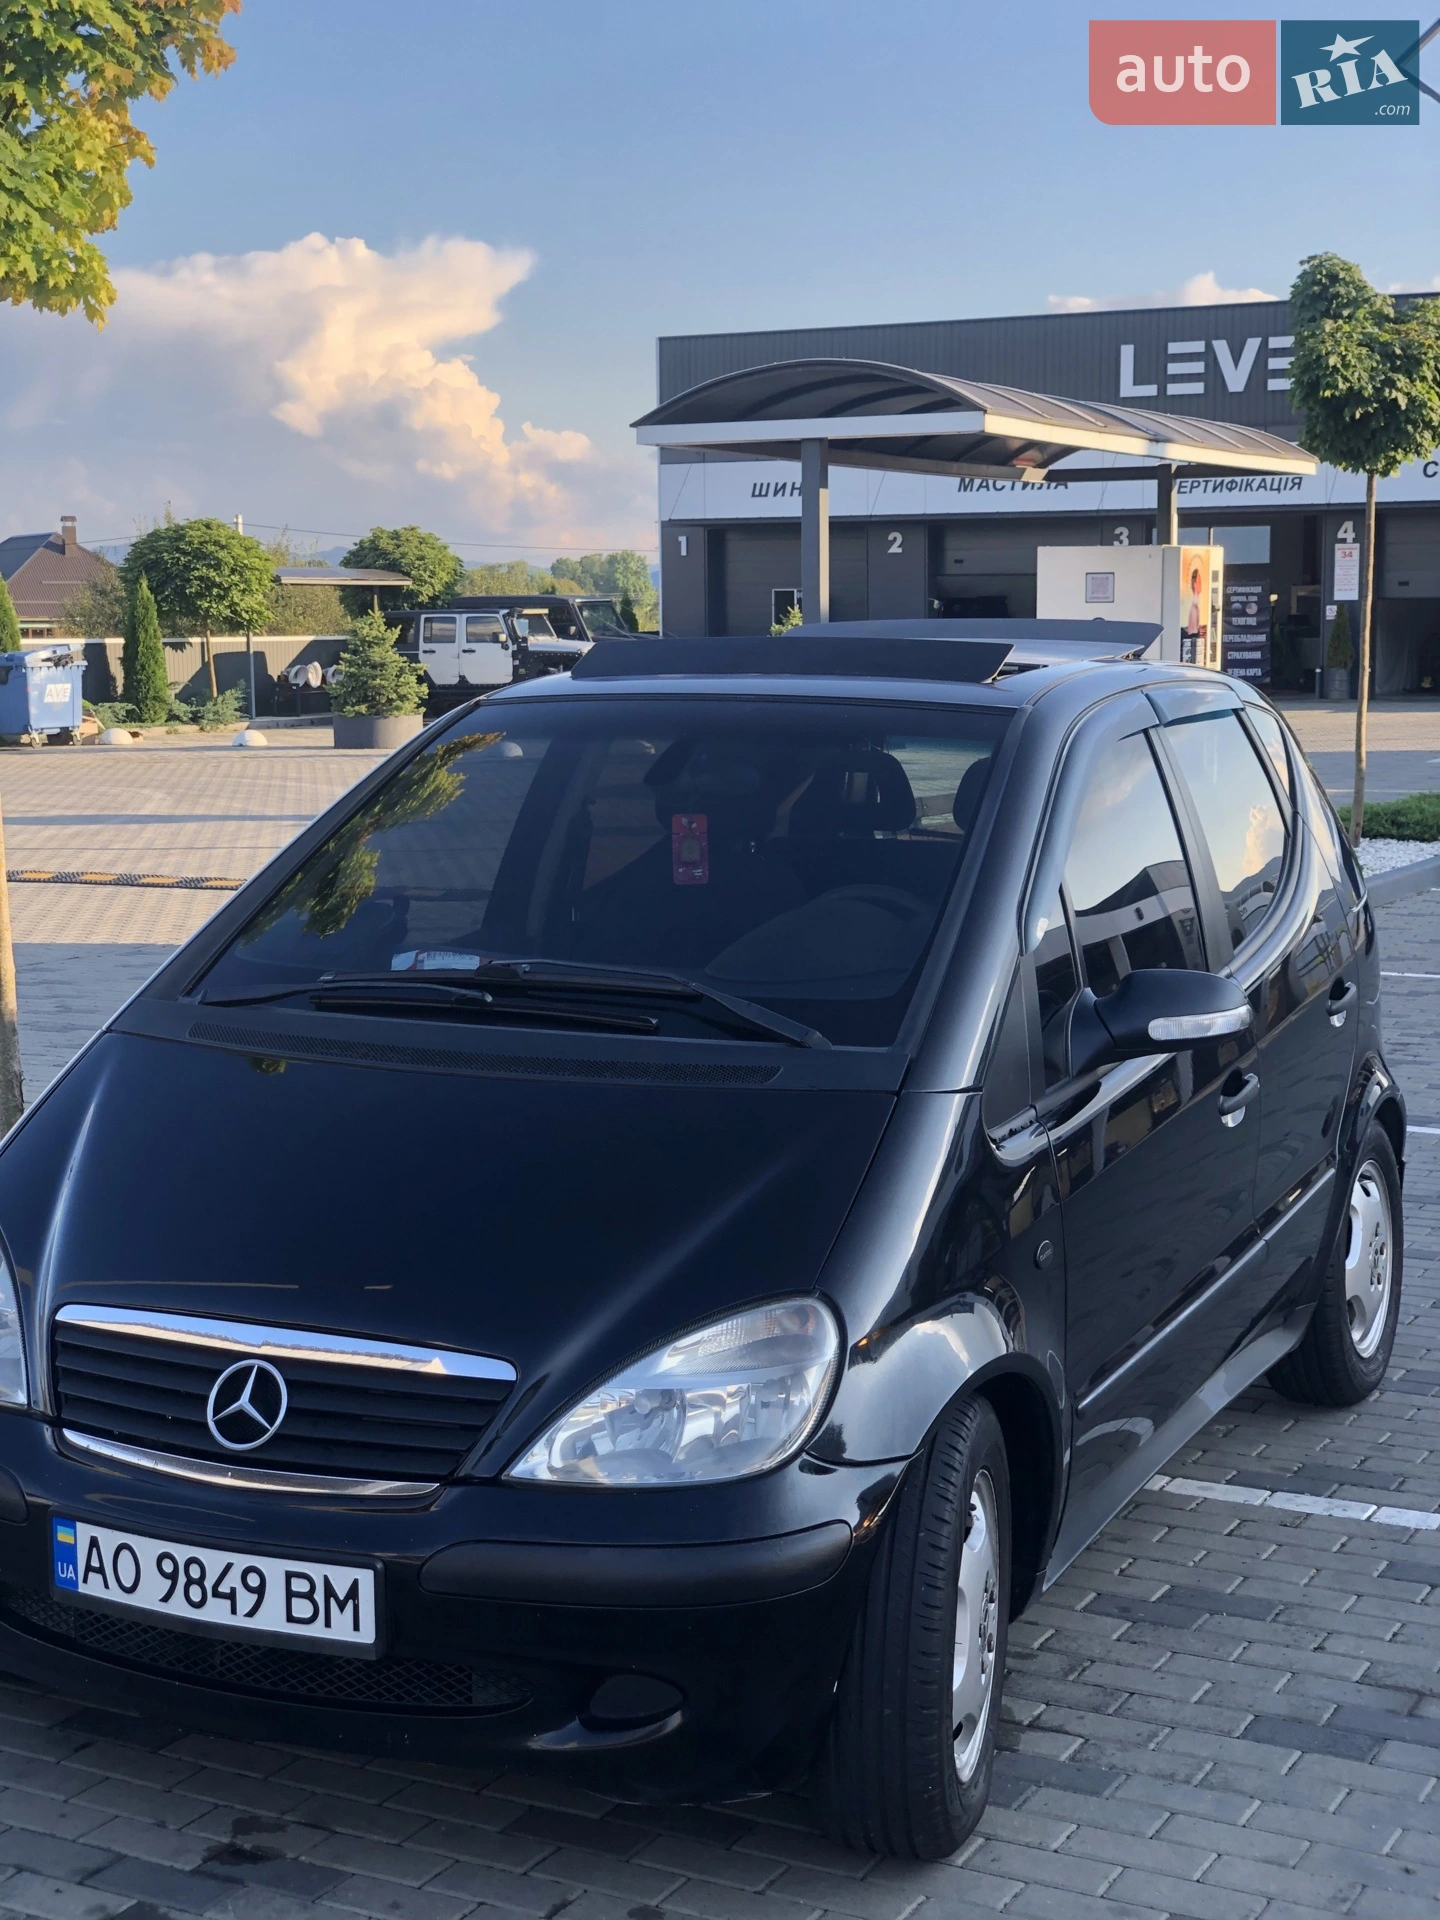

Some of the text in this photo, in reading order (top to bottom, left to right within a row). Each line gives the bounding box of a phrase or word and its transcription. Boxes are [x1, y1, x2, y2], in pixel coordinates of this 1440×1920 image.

[1119, 335, 1296, 398] LEVE
[751, 481, 803, 498] ШИН
[1177, 476, 1304, 495] ЕРТИФІКАЦІЯ
[1113, 526, 1130, 546] 3
[1337, 520, 1356, 544] 4
[678, 535, 688, 556] 1
[887, 531, 903, 554] 2
[1341, 550, 1353, 559] 34
[46, 687, 70, 698] AVE
[57, 1561, 76, 1581] UA
[82, 1535, 361, 1632] AO 9849 BM
